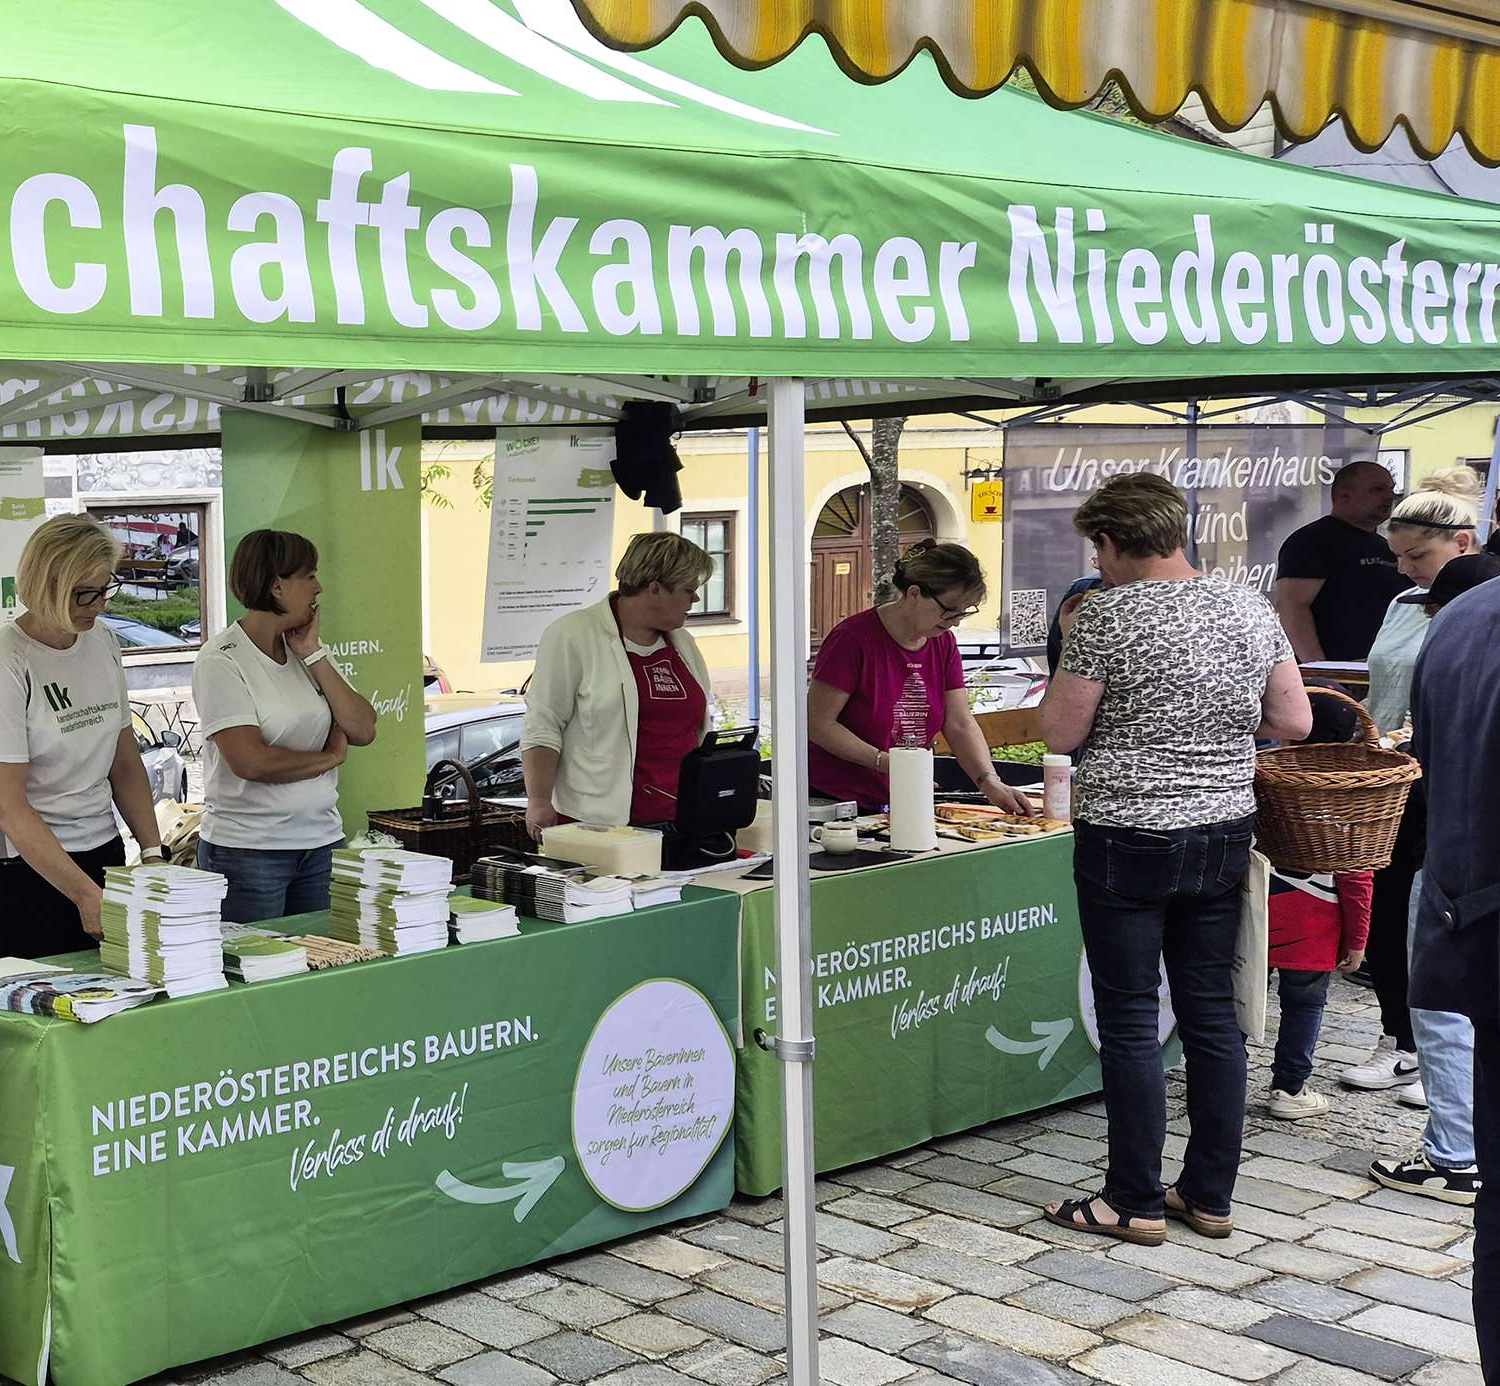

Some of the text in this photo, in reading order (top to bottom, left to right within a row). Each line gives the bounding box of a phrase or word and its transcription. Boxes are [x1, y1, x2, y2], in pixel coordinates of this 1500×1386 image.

[360, 428, 405, 491] lk
[1157, 446, 1336, 489] Krankenhaus
[43, 682, 73, 712] lk
[981, 903, 1058, 940] BAUERN.
[817, 965, 912, 1010] KAMMER.
[891, 956, 1012, 1040] Verlass di drauf!
[91, 1015, 540, 1136] NIEDERÖSTERREICHS BAUERN.
[602, 1047, 706, 1078] Unsere Bäuerinnen
[613, 1072, 694, 1100] und Bauern in
[607, 1092, 696, 1129] Niederösterreich
[92, 1099, 321, 1177] EINE KAMMER.
[289, 1082, 469, 1192] Verlass di drauf!
[586, 1135, 628, 1167] sorgen
